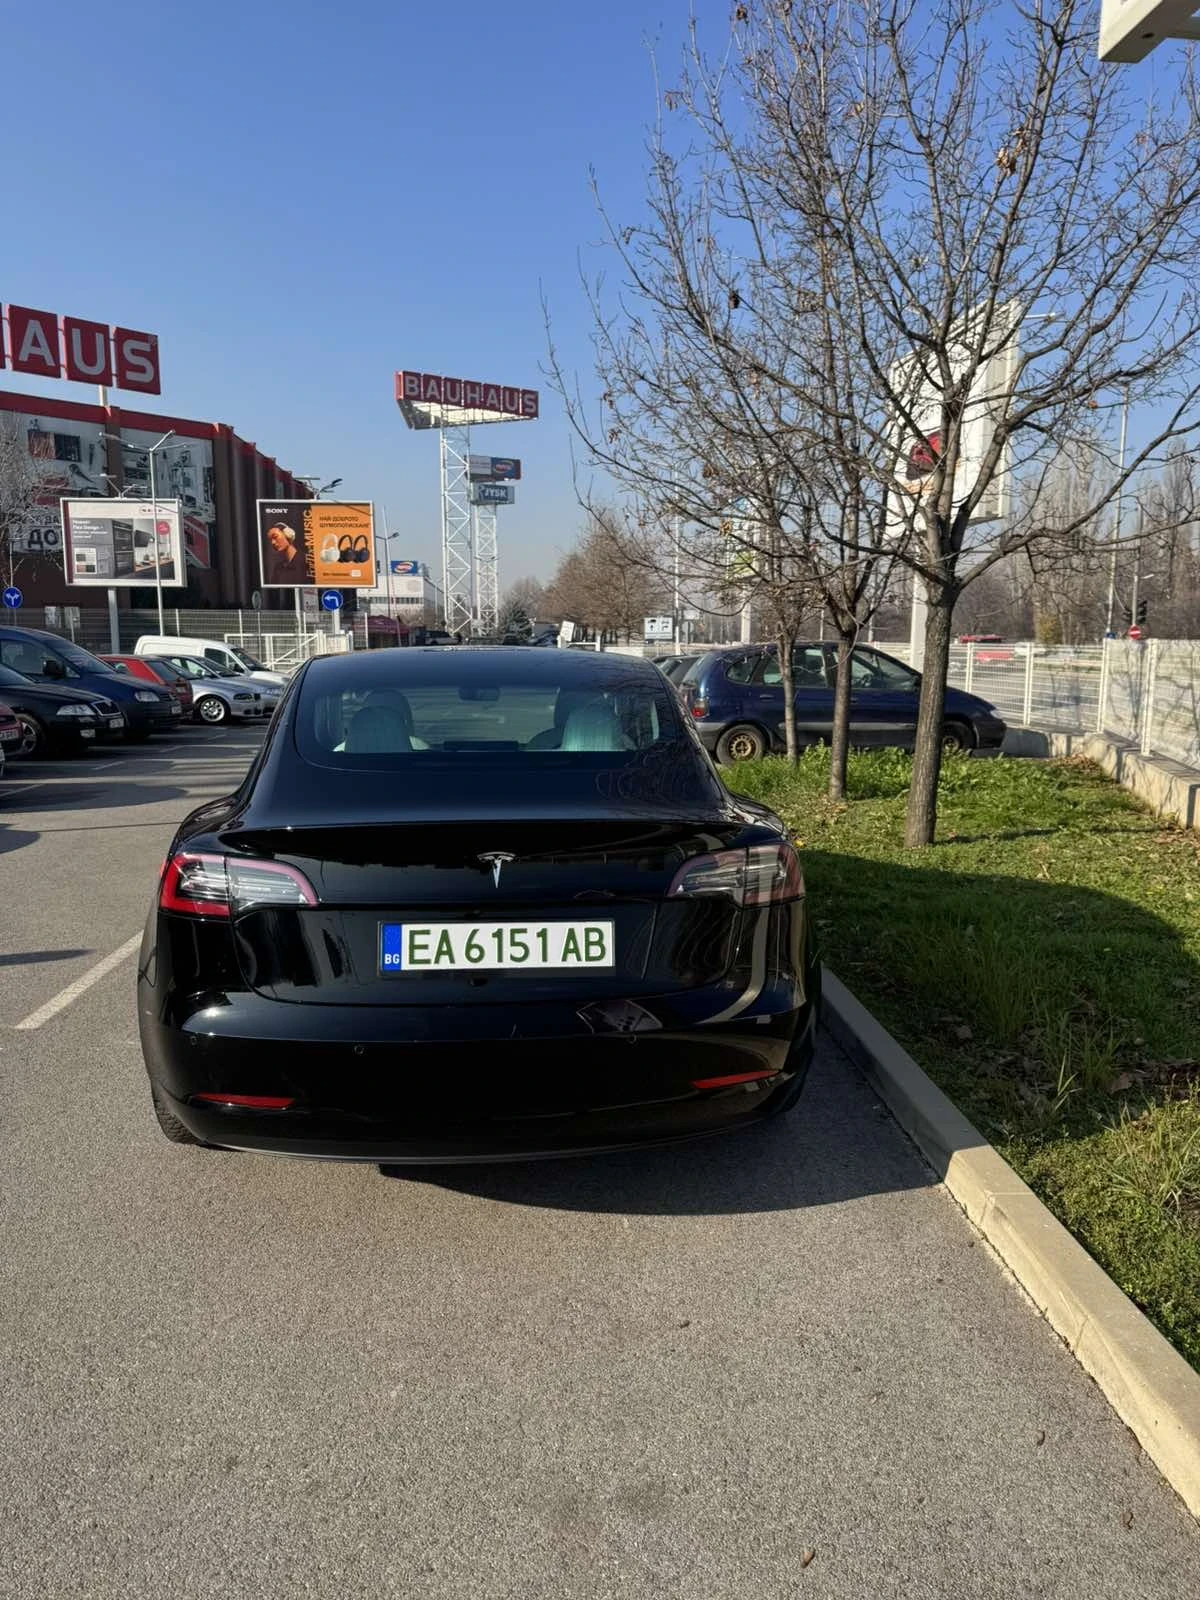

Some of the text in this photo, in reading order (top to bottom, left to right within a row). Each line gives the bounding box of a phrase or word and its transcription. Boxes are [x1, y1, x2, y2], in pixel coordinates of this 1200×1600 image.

[404, 375, 538, 414] BAUHAUS
[485, 487, 507, 498] JYSK
[303, 509, 314, 547] MUSIC
[384, 954, 400, 964] BG
[408, 927, 606, 965] EA 6151 AB
